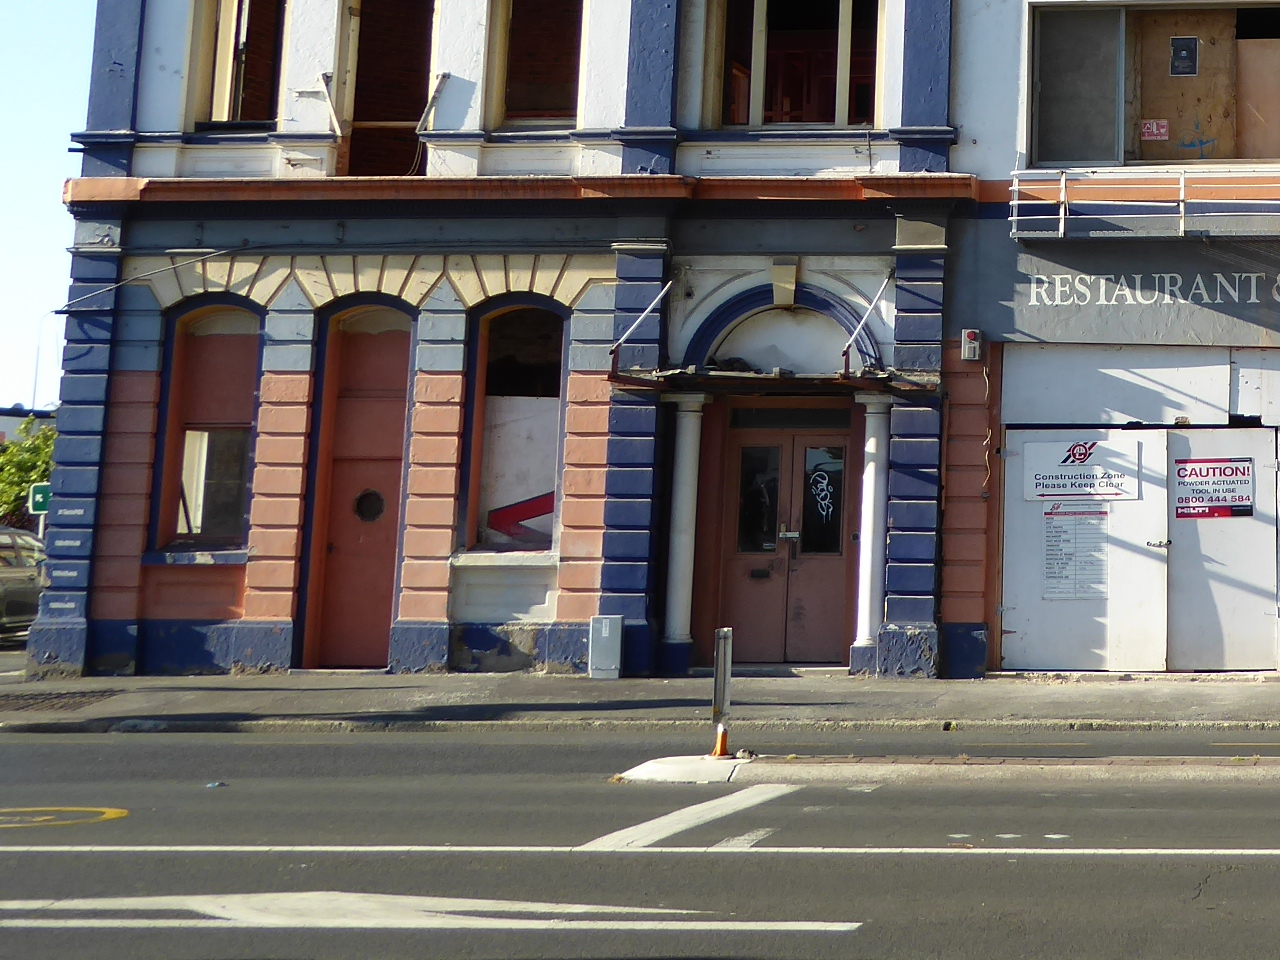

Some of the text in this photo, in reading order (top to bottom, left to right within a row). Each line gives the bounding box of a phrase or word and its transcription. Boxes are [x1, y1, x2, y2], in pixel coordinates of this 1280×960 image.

[1027, 270, 1265, 306] RESTAURANT
[1034, 472, 1126, 480] Construction Zone
[1176, 466, 1251, 478] CAUTION!
[1035, 480, 1124, 489] Please Keep Clear
[1177, 495, 1251, 504] 0800 444 584
